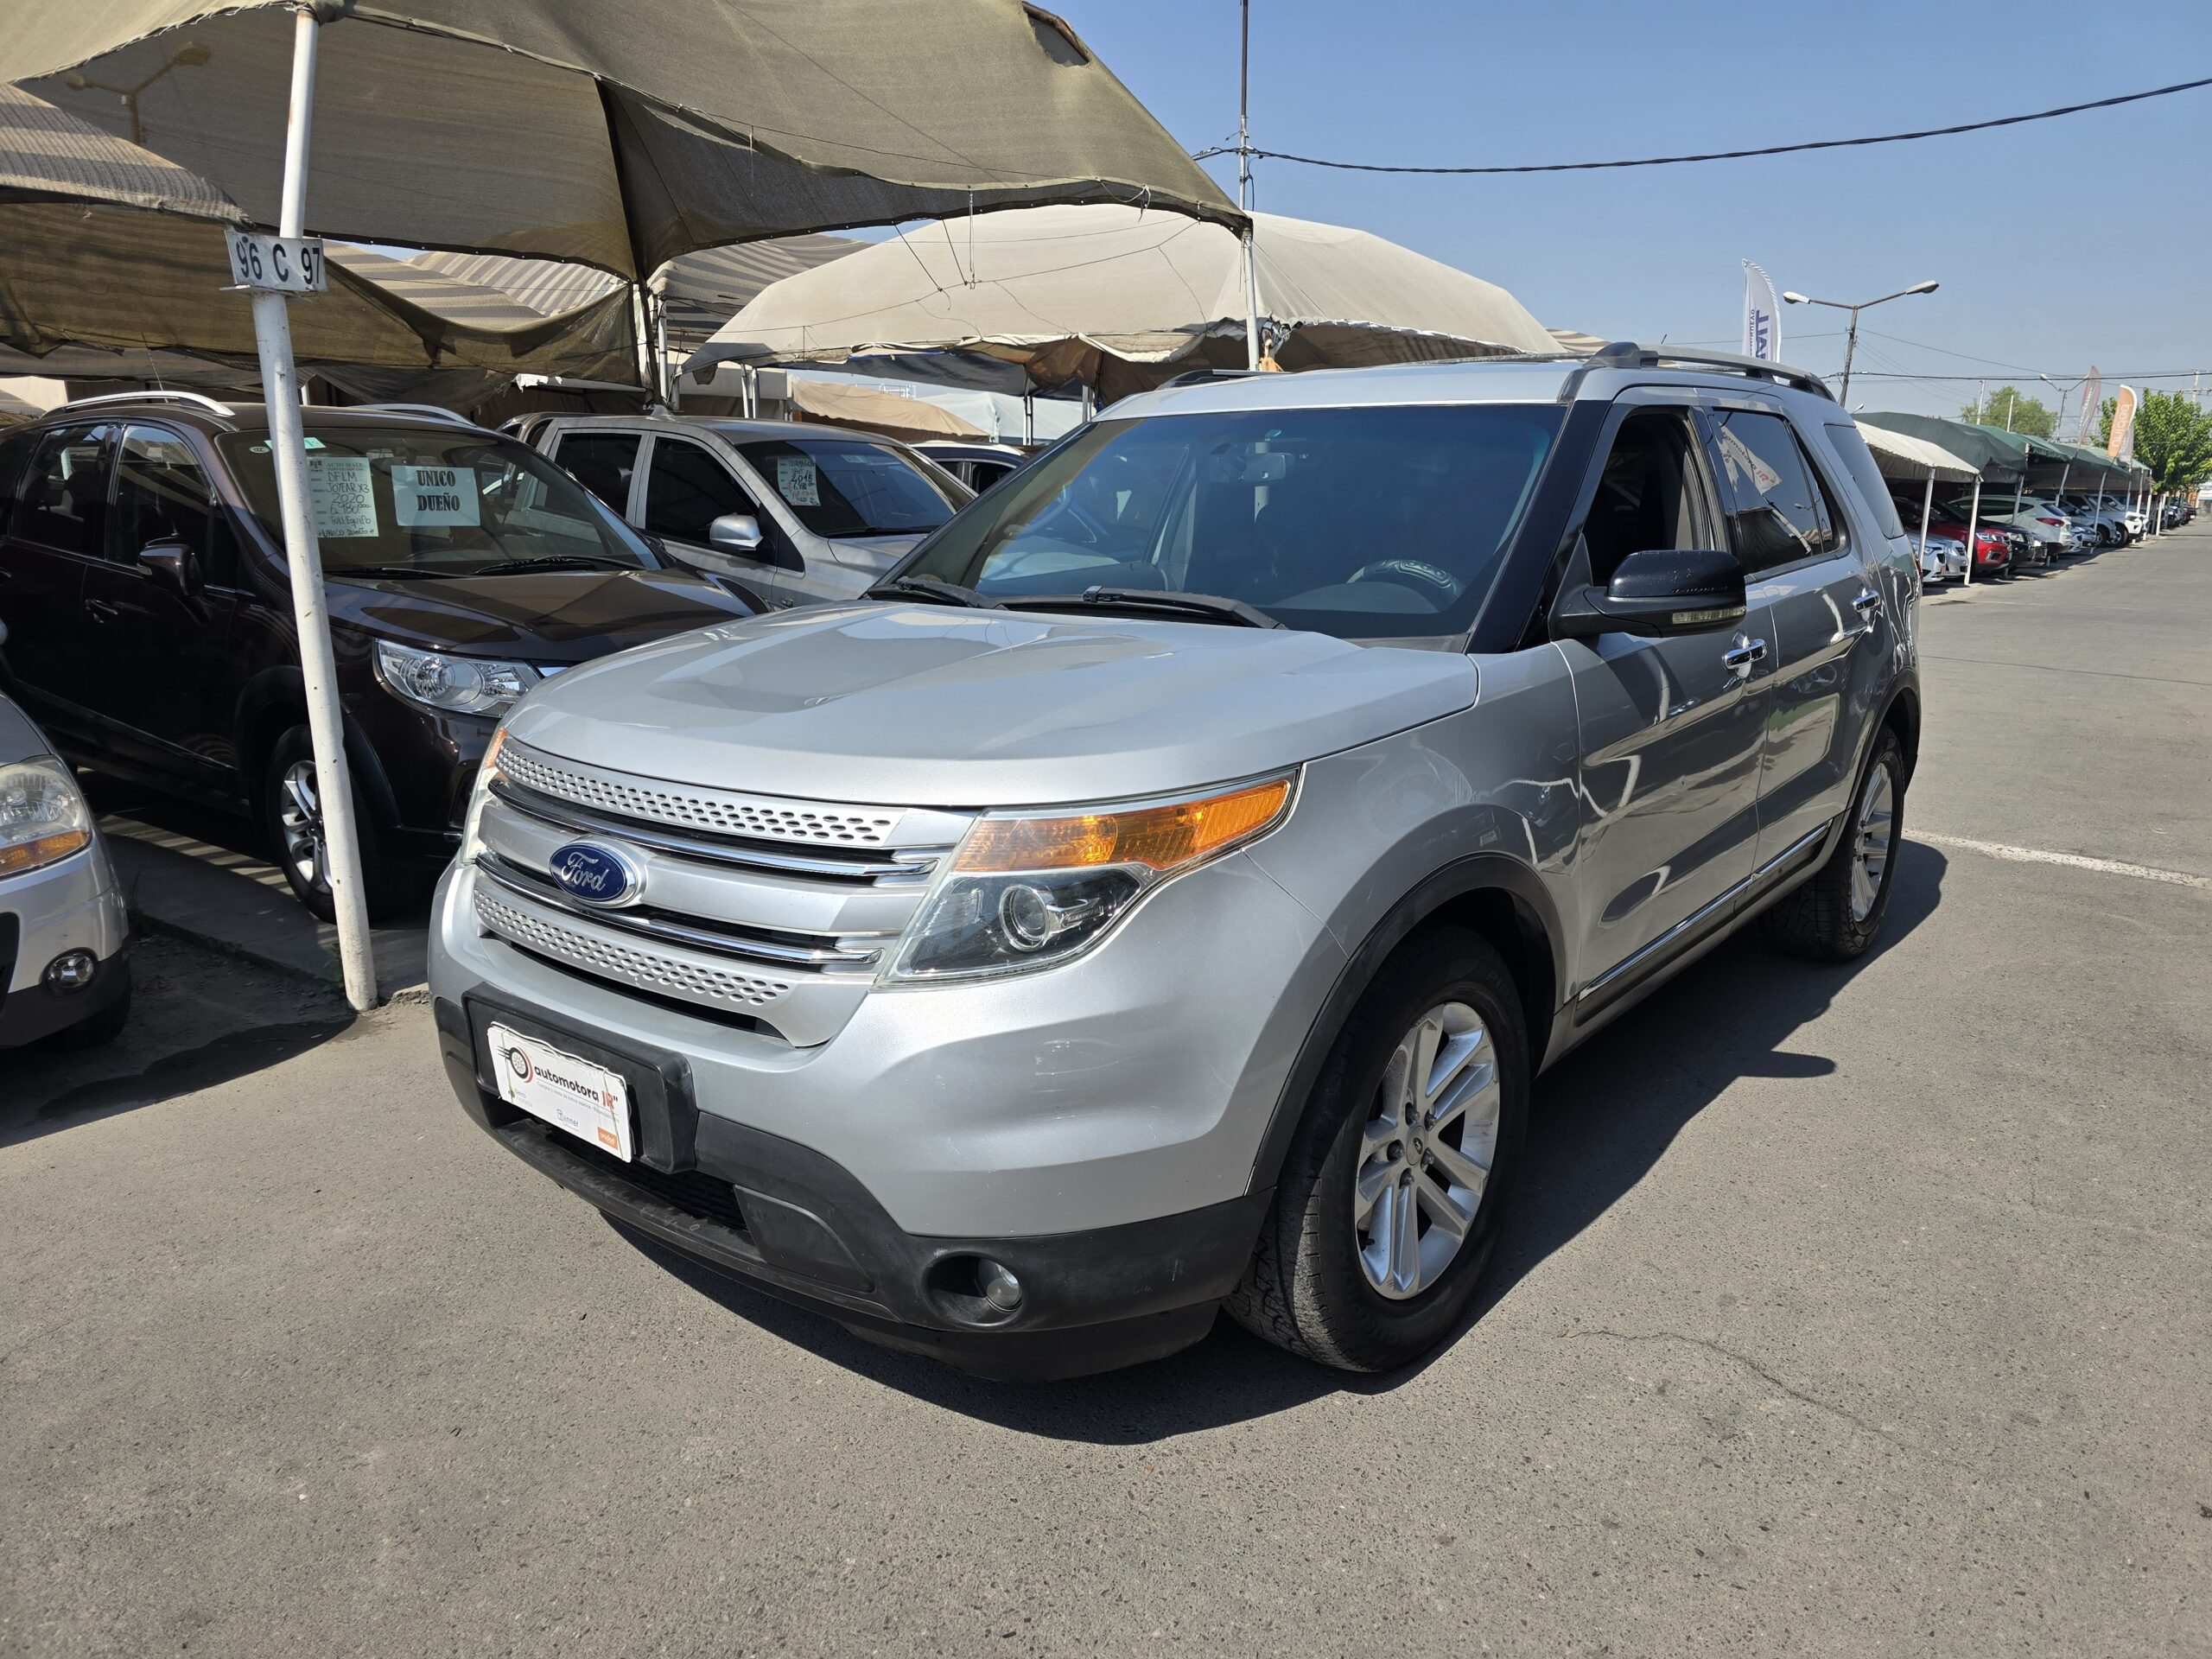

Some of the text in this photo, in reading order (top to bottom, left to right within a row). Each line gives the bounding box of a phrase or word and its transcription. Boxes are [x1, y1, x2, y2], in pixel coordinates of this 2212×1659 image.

[236, 241, 320, 284] 96 C 97
[416, 470, 456, 487] UNICO
[332, 493, 365, 504] 2020
[416, 492, 461, 512] DUEÑO
[561, 852, 609, 892] Ford
[534, 1065, 599, 1103] automotora
